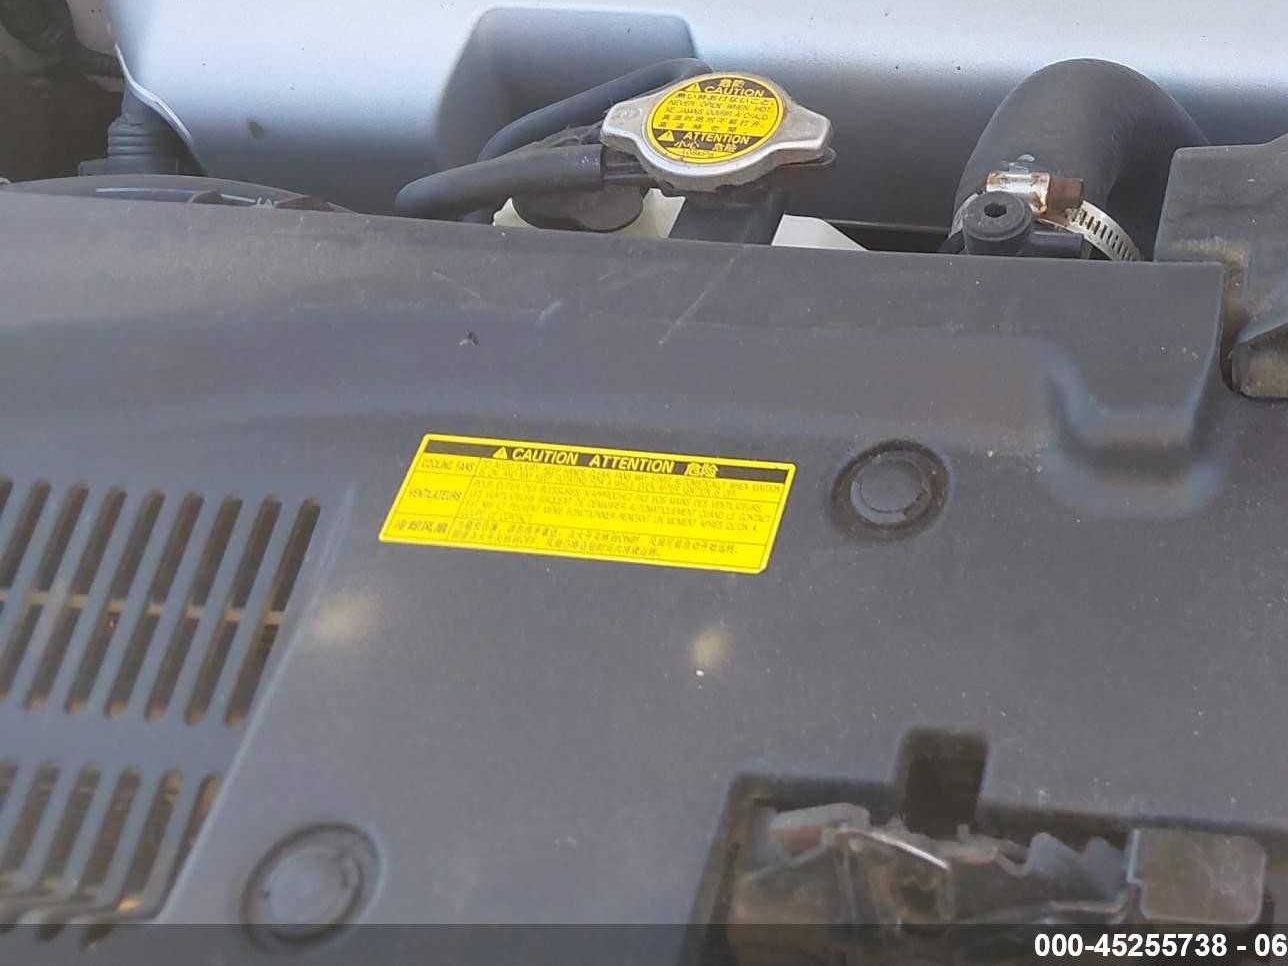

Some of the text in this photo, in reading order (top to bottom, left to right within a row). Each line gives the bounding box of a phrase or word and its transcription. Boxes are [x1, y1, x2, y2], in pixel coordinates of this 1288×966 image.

[703, 85, 766, 98] CAUTION
[700, 101, 721, 110] OPEN
[727, 103, 750, 112] WHEN
[683, 131, 751, 145] ATTENTION
[420, 457, 453, 470] COOLING
[456, 459, 475, 472] FANS
[511, 448, 579, 466] CAUTION
[588, 454, 676, 475] ATTENTION
[409, 487, 463, 502] VENTILATEURS
